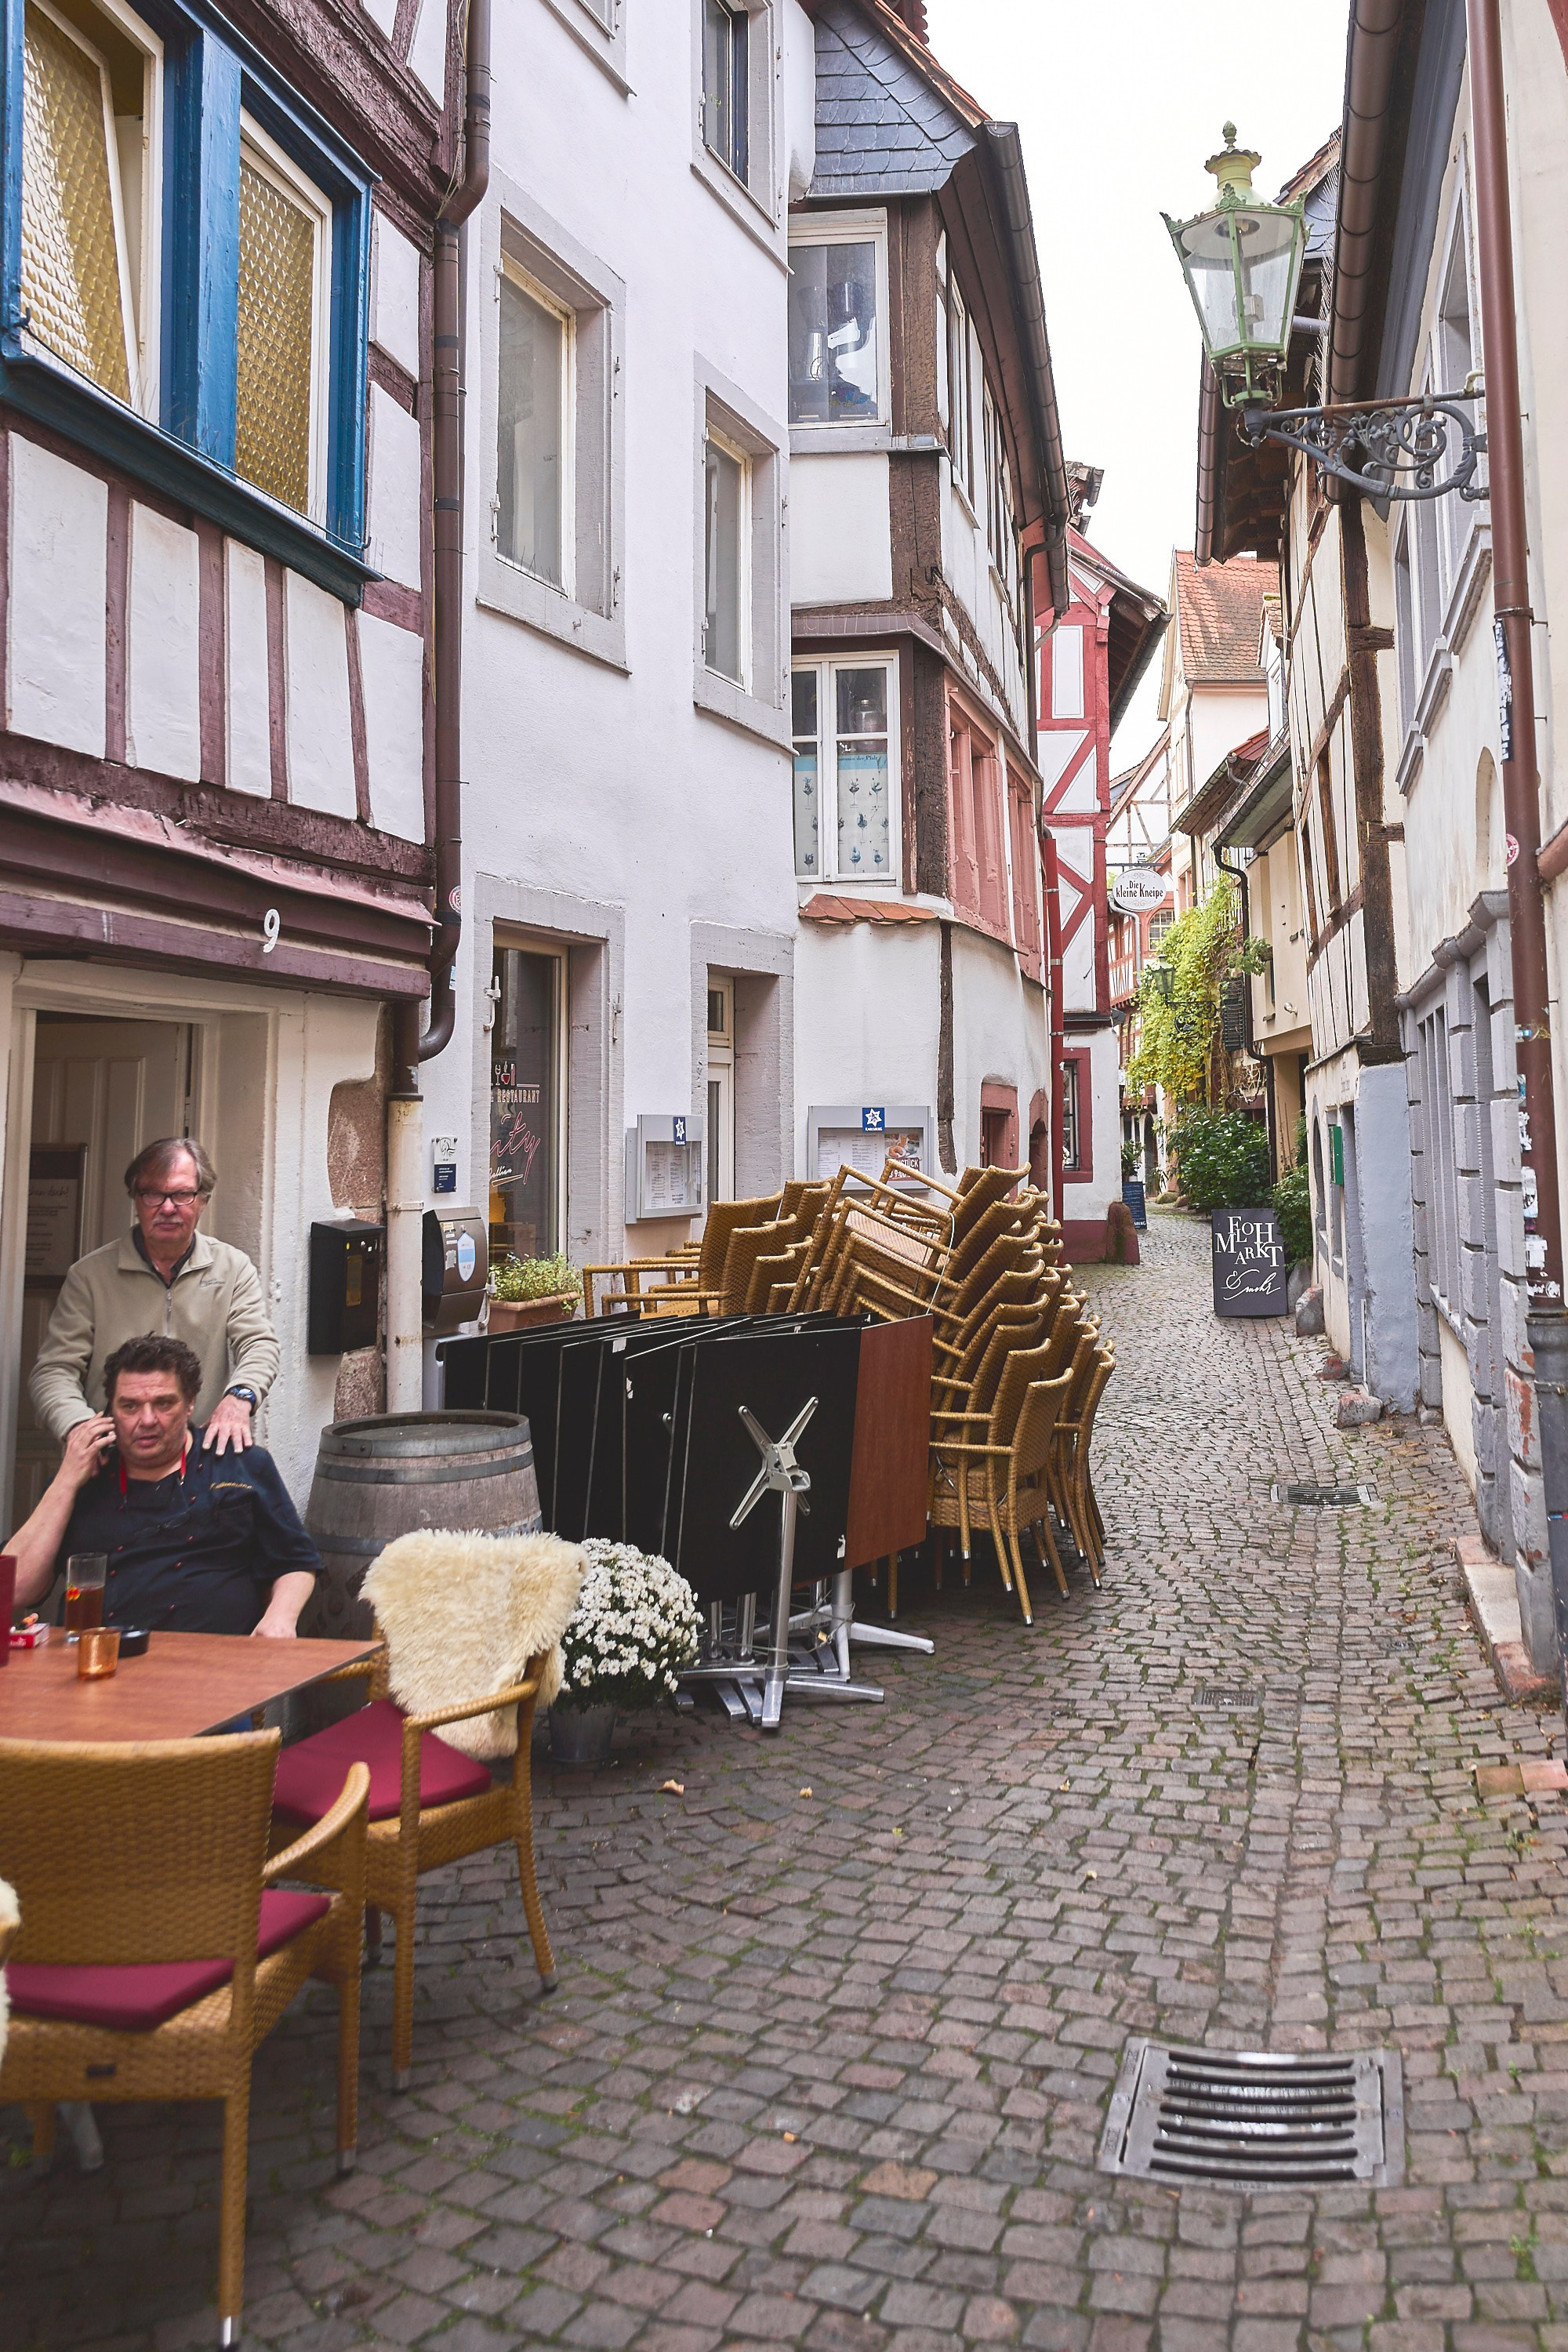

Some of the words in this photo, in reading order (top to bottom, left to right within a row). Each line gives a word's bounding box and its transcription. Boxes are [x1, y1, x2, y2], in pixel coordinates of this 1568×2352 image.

[1116, 884, 1138, 898] kleine
[1139, 882, 1163, 899] Kneipe
[1129, 880, 1139, 889] Die
[263, 908, 281, 953] 9
[497, 1088, 540, 1103] RESTAURANT
[1227, 1216, 1276, 1244] FLOH
[1214, 1232, 1283, 1268] MARKT
[1223, 1272, 1281, 1301] mehr
